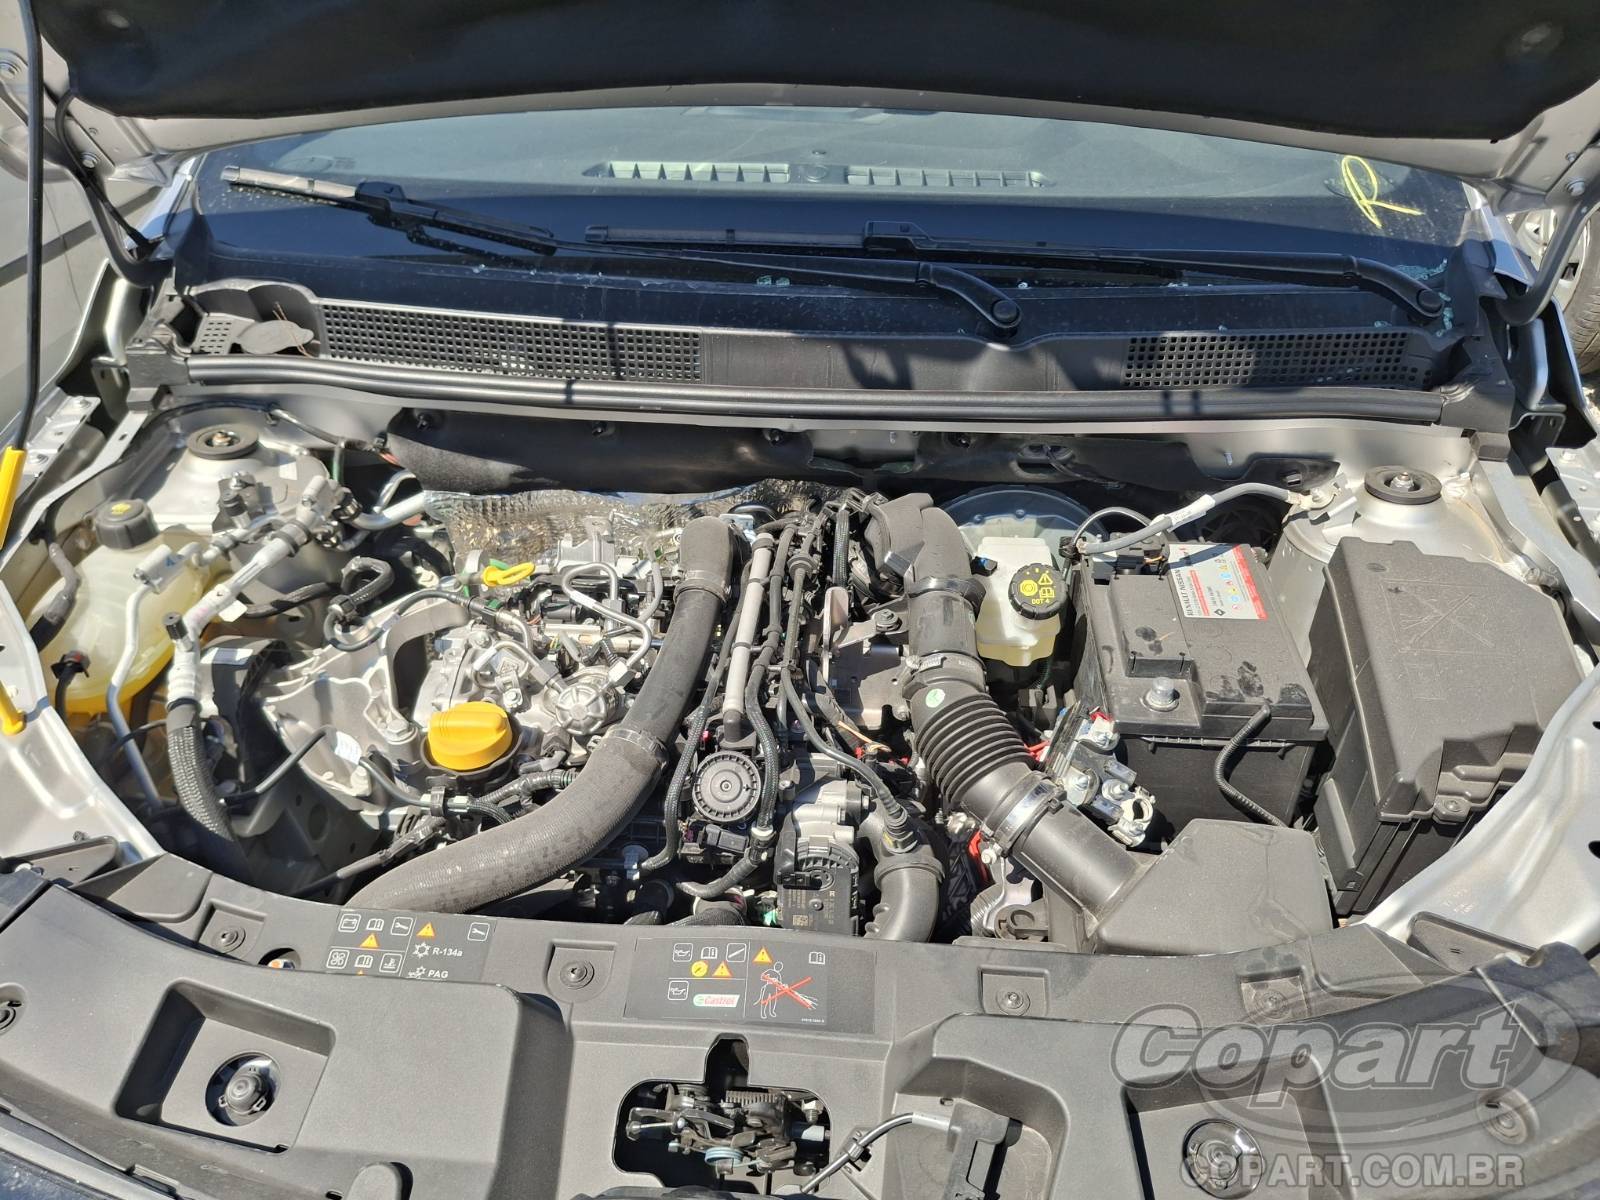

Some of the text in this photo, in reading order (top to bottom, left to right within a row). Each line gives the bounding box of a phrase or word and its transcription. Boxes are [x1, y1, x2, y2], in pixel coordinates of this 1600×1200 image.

[1174, 569, 1186, 591] NISSAN
[432, 946, 463, 957] R-134a
[427, 969, 449, 979] PAG
[704, 994, 737, 1005] Castrol
